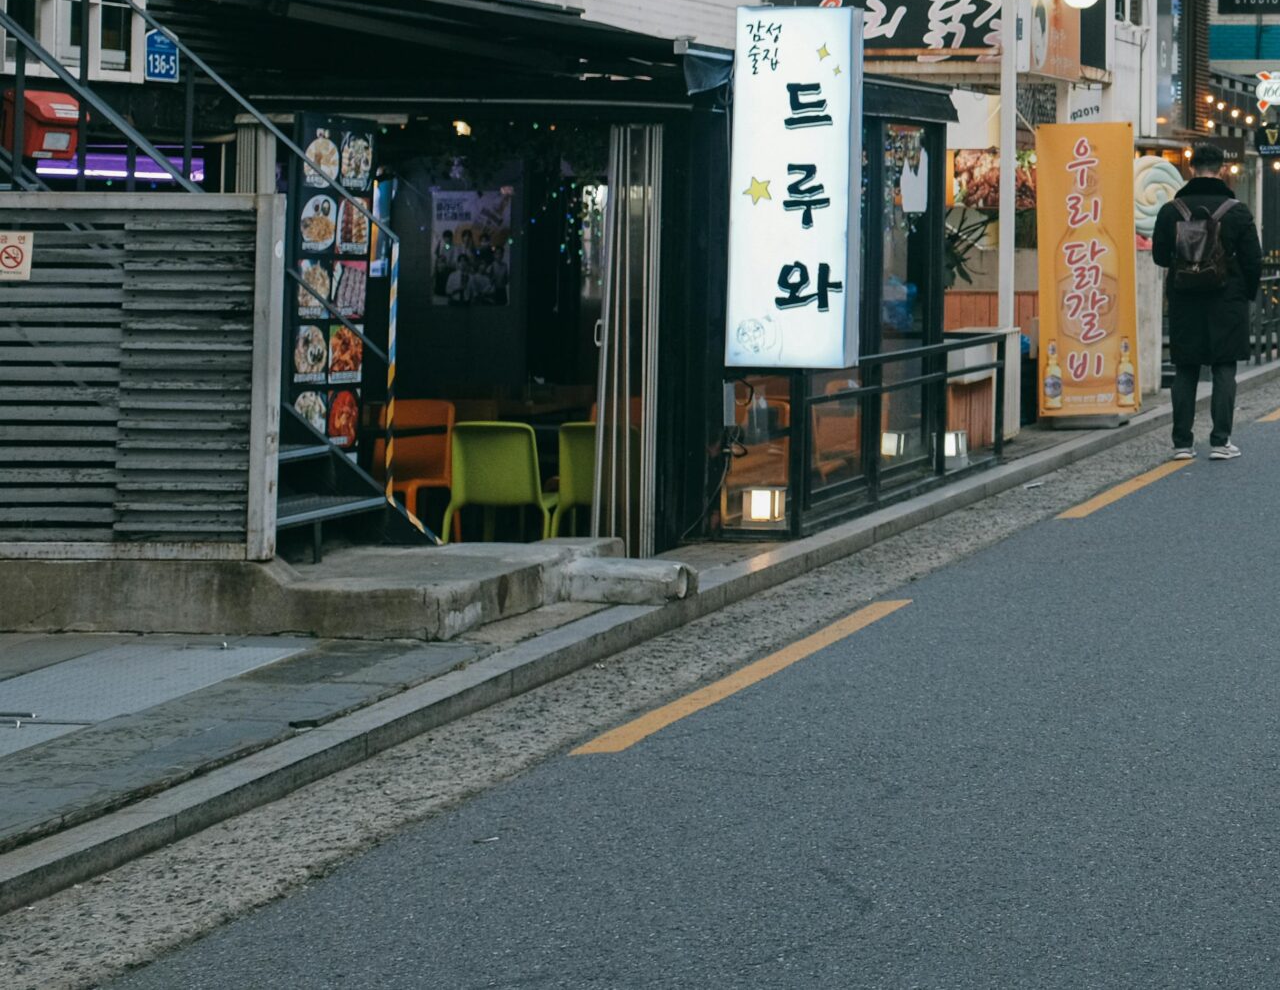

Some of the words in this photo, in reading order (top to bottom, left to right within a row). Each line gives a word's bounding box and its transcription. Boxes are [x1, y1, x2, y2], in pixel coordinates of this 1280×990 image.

[746, 21, 782, 44] 감성
[149, 54, 176, 75] 136-5
[747, 44, 780, 75] 술집
[775, 83, 843, 312] 드루와
